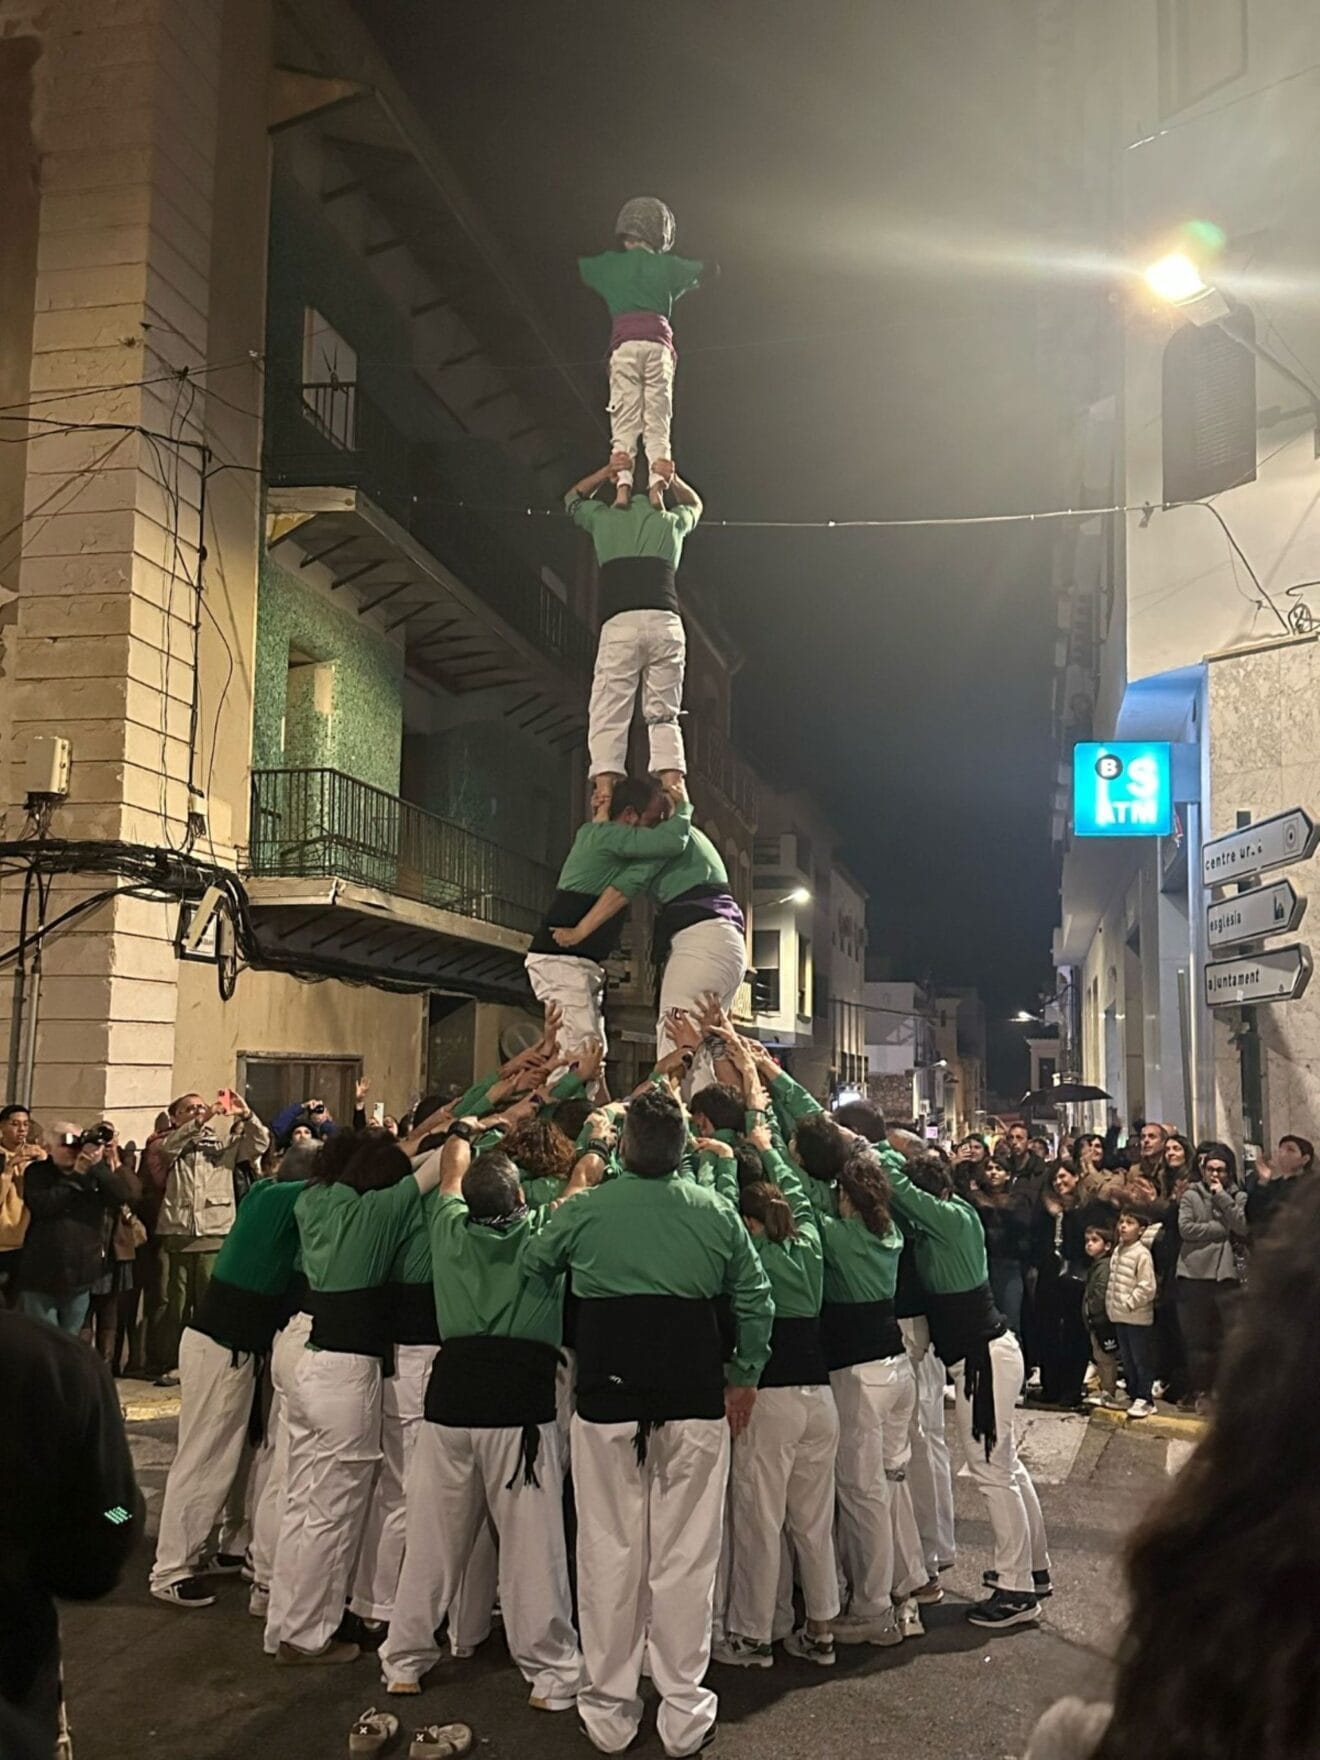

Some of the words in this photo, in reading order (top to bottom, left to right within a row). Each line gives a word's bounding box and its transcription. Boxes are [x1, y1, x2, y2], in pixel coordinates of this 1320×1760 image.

[1096, 799, 1158, 824] ATM
[1205, 850, 1236, 871] centre
[1208, 967, 1260, 992] ajuntament
